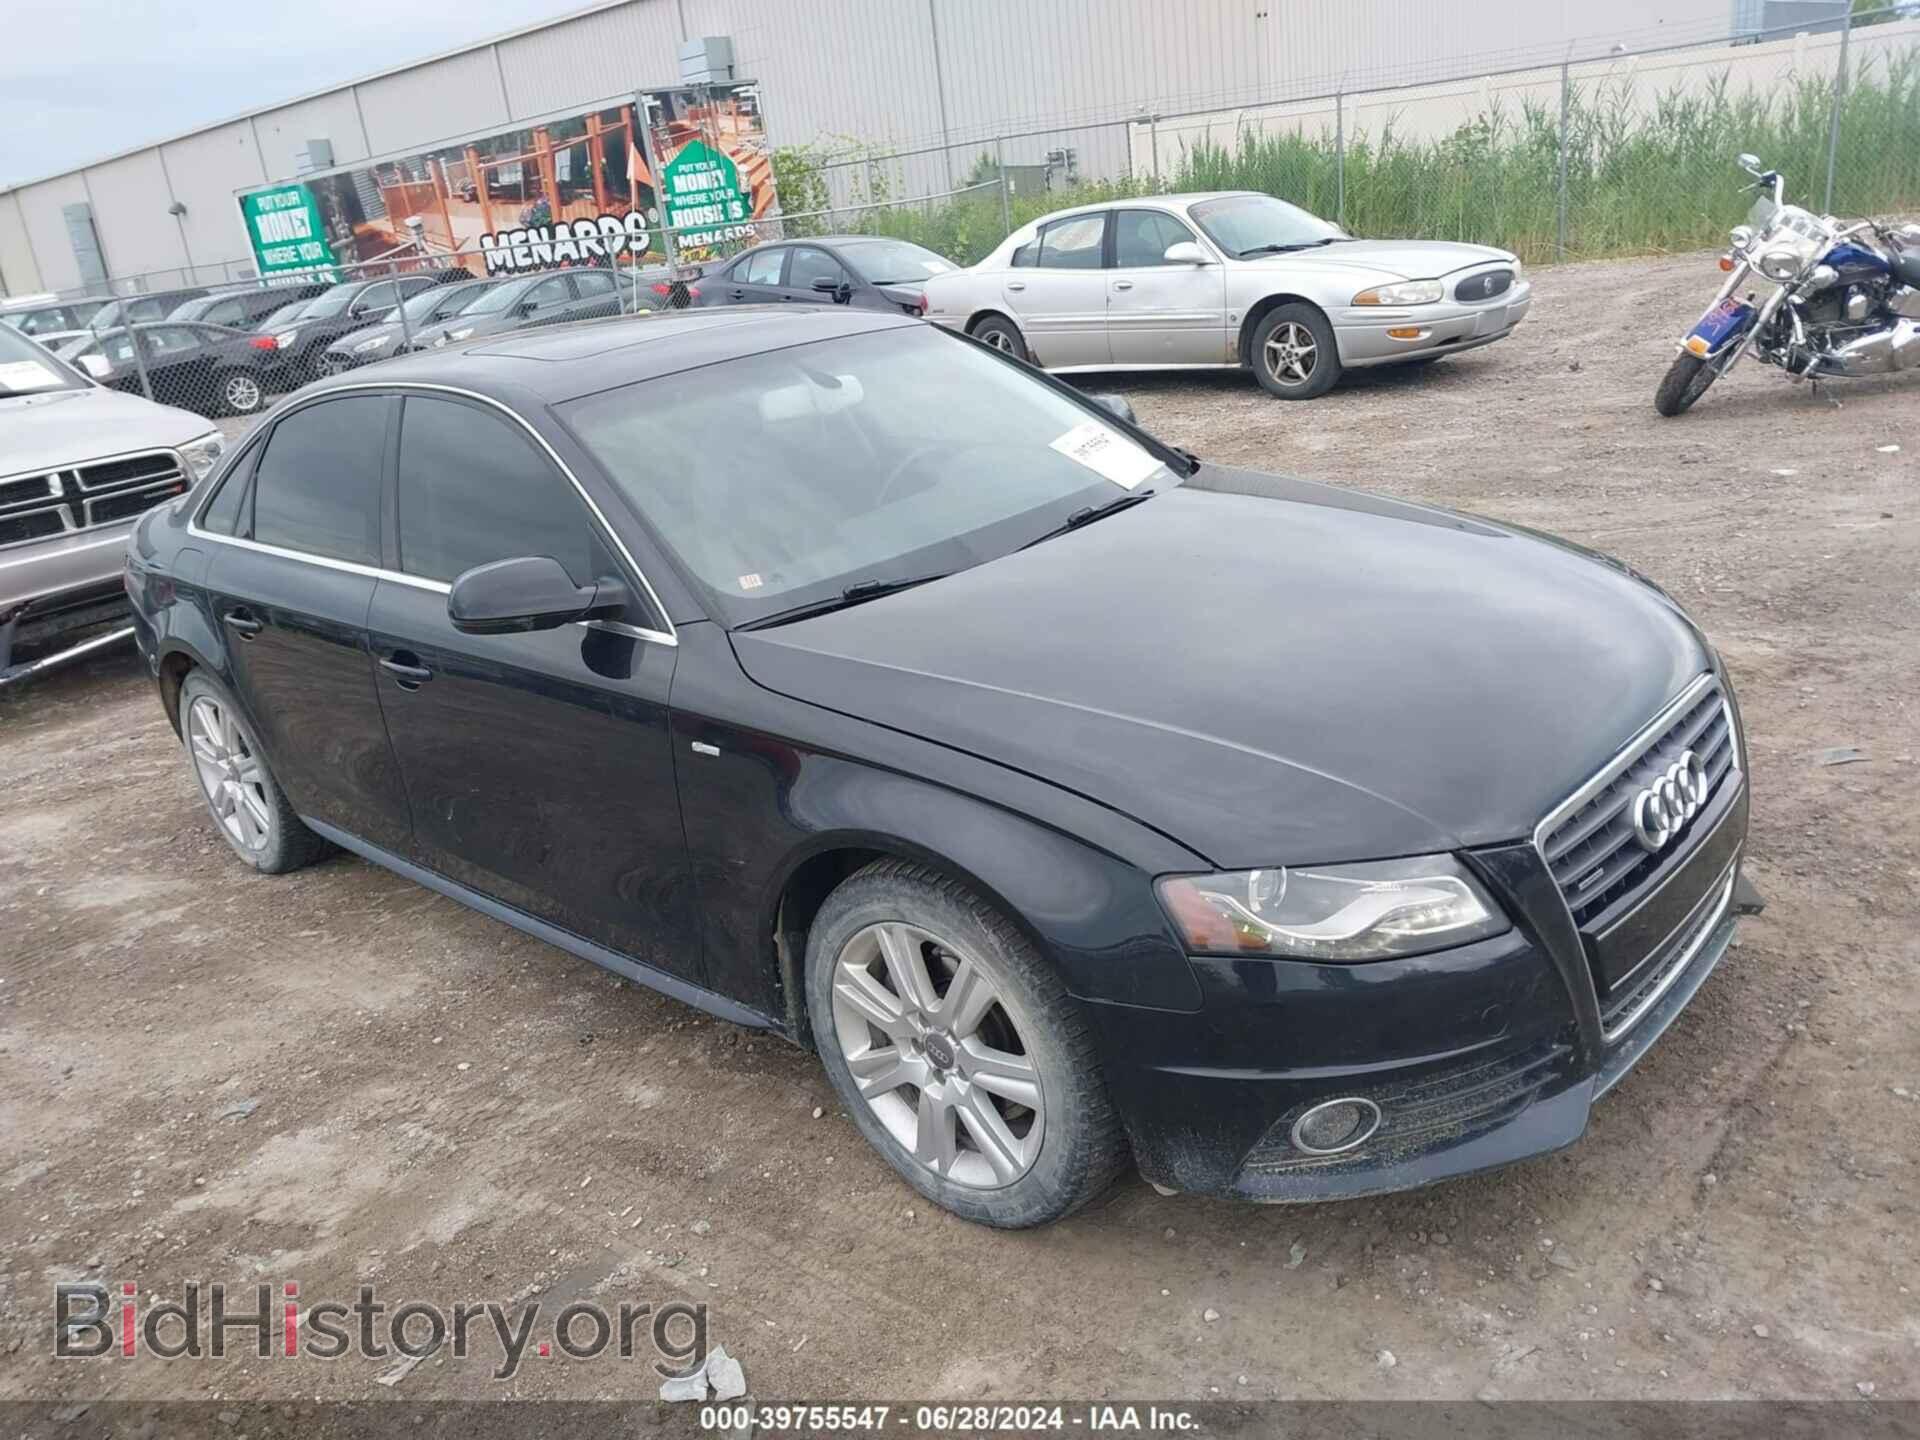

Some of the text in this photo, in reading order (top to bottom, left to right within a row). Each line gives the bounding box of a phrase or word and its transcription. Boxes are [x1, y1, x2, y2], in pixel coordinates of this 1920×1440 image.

[678, 162, 697, 174] PUT
[672, 169, 727, 193] MONEY
[673, 188, 735, 207] WHERE YOUR
[254, 206, 313, 244] MONEY
[671, 200, 744, 228] HOUSE IS
[480, 211, 651, 274] MENARDS
[677, 224, 755, 249] MENARDS
[261, 241, 325, 266] WHERE YOUR
